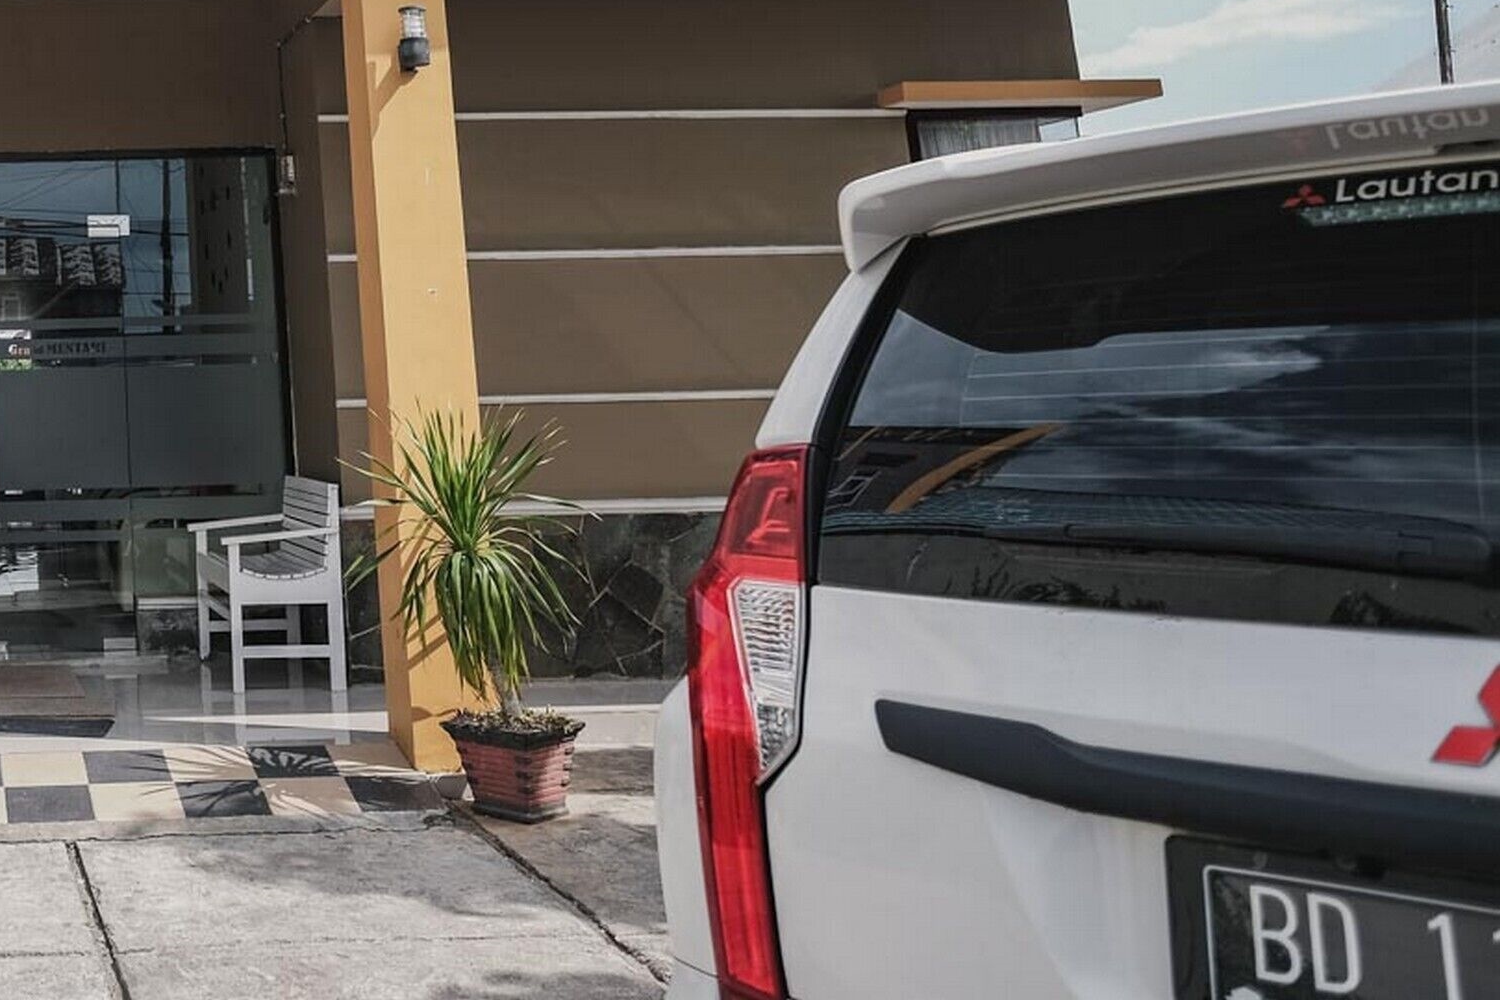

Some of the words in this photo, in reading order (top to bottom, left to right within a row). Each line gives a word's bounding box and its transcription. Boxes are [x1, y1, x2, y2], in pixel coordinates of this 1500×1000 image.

[1335, 169, 1499, 203] Lautan
[1250, 884, 1363, 994] BD
[1426, 912, 1500, 1000] 1
